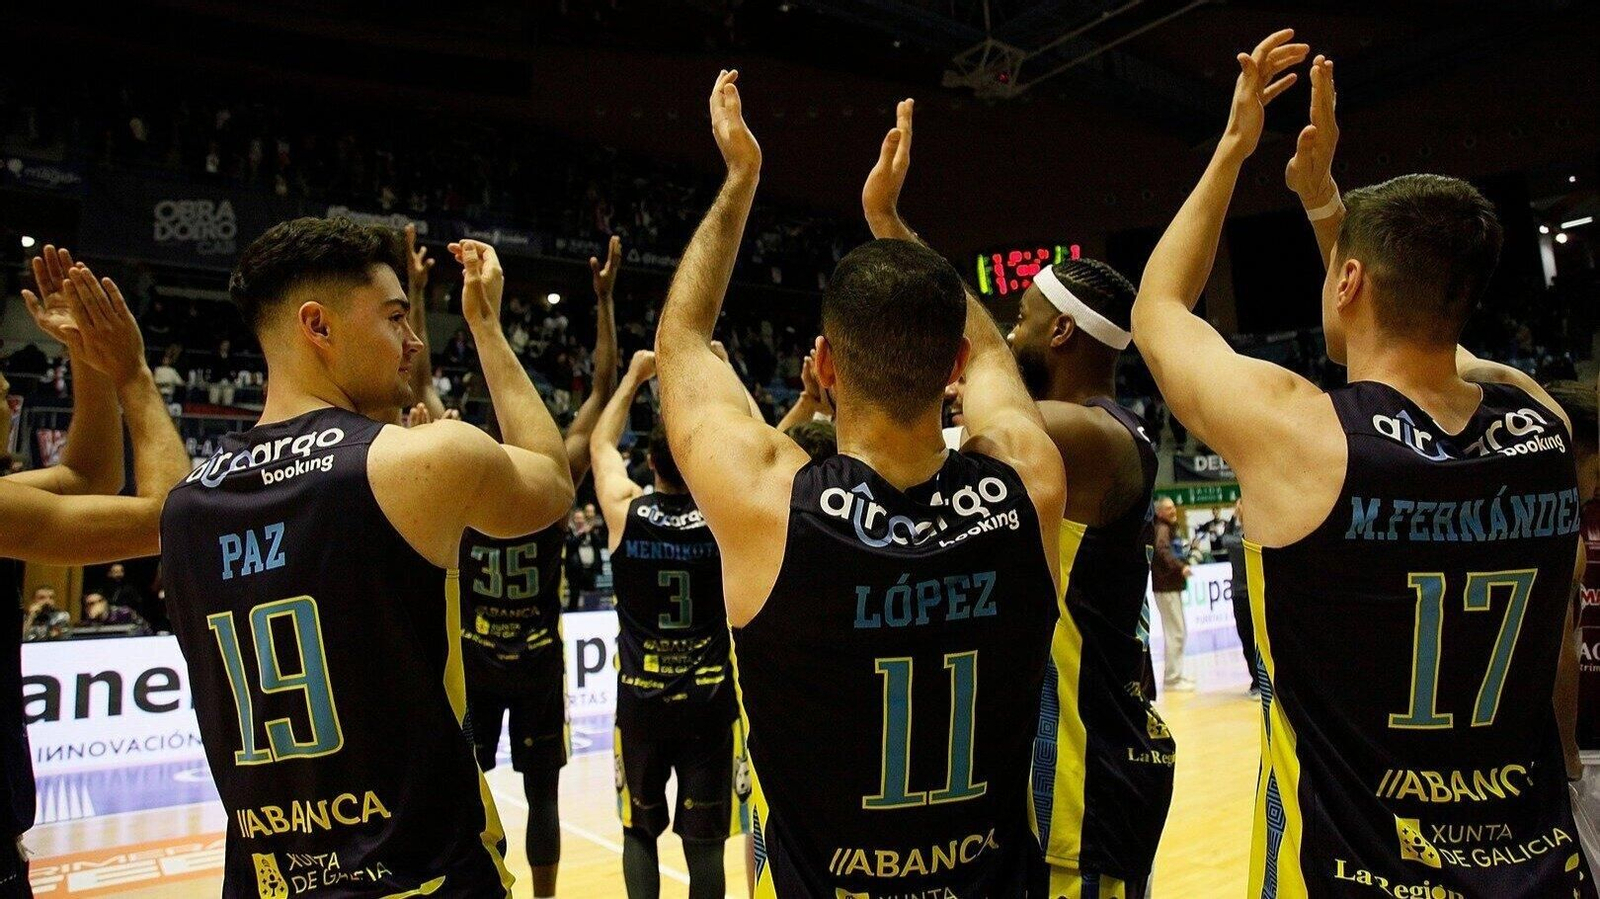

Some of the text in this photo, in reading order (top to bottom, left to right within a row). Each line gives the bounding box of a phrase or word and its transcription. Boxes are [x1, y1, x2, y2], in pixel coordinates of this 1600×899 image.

[154, 199, 234, 220] OBRA
[153, 220, 237, 241] DOIRO
[261, 453, 335, 486] booking
[939, 508, 1020, 549] booking
[219, 522, 287, 581] PAZ
[625, 539, 718, 561] MENDIKOT
[471, 542, 540, 600] 35
[658, 570, 692, 630] 3
[853, 570, 998, 629] LÓPEZ
[1388, 568, 1538, 729] 17
[22, 666, 194, 725] ane
[207, 594, 344, 767] 19
[862, 650, 988, 810] 11
[1395, 762, 1534, 803] ABANC
[1431, 822, 1513, 844] XUNTA
[1438, 827, 1573, 868] DE GALICIA
[290, 870, 318, 894] DE
